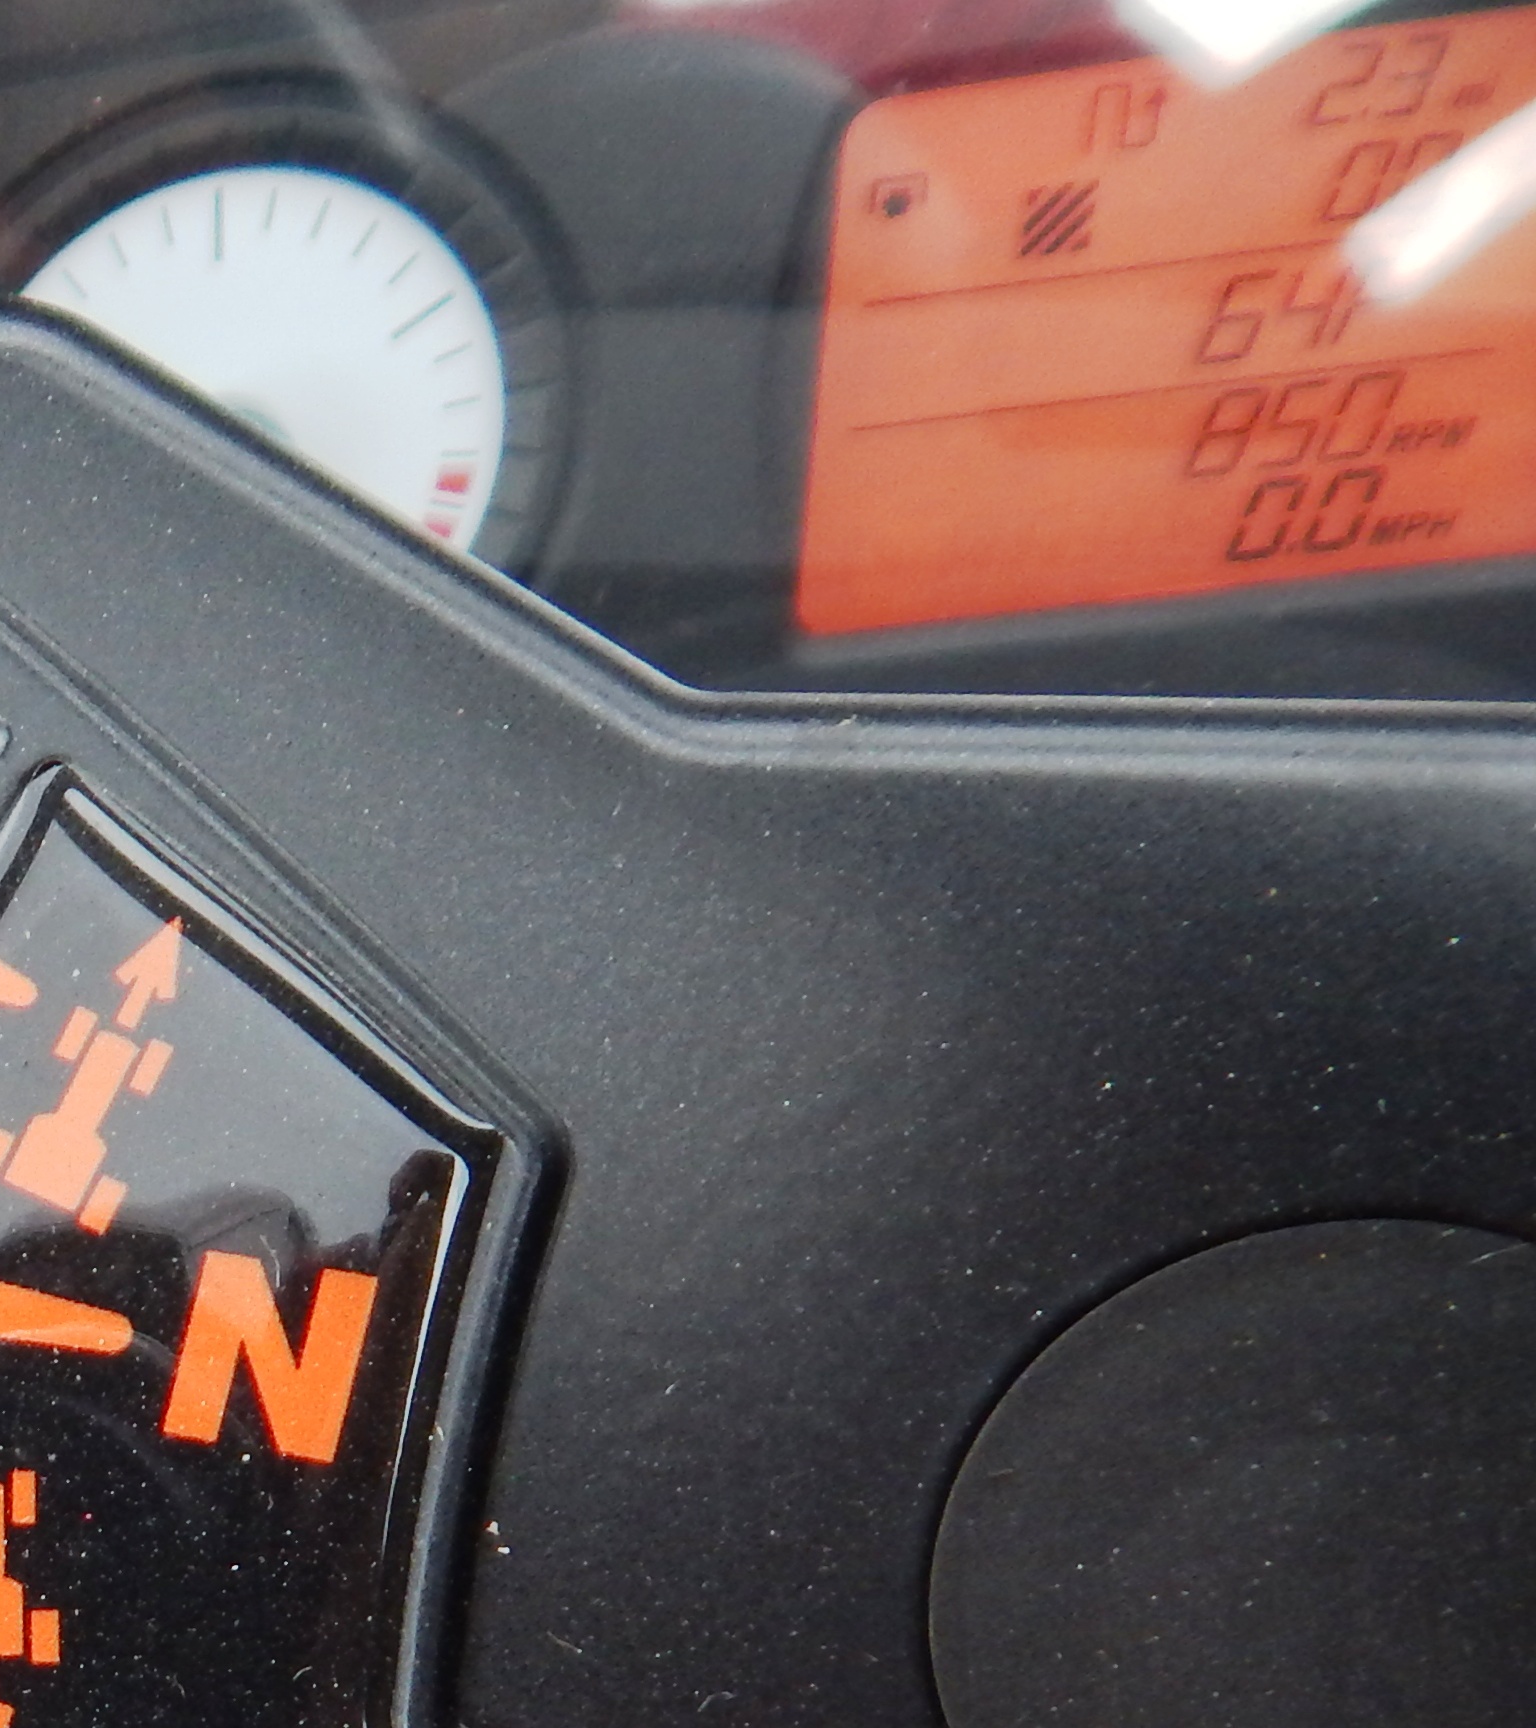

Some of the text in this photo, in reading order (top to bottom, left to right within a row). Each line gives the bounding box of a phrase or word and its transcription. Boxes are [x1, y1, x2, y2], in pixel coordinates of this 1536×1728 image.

[1186, 371, 1479, 478] 850 RPM
[1368, 509, 1460, 545] MPH
[160, 1249, 379, 1465] N
